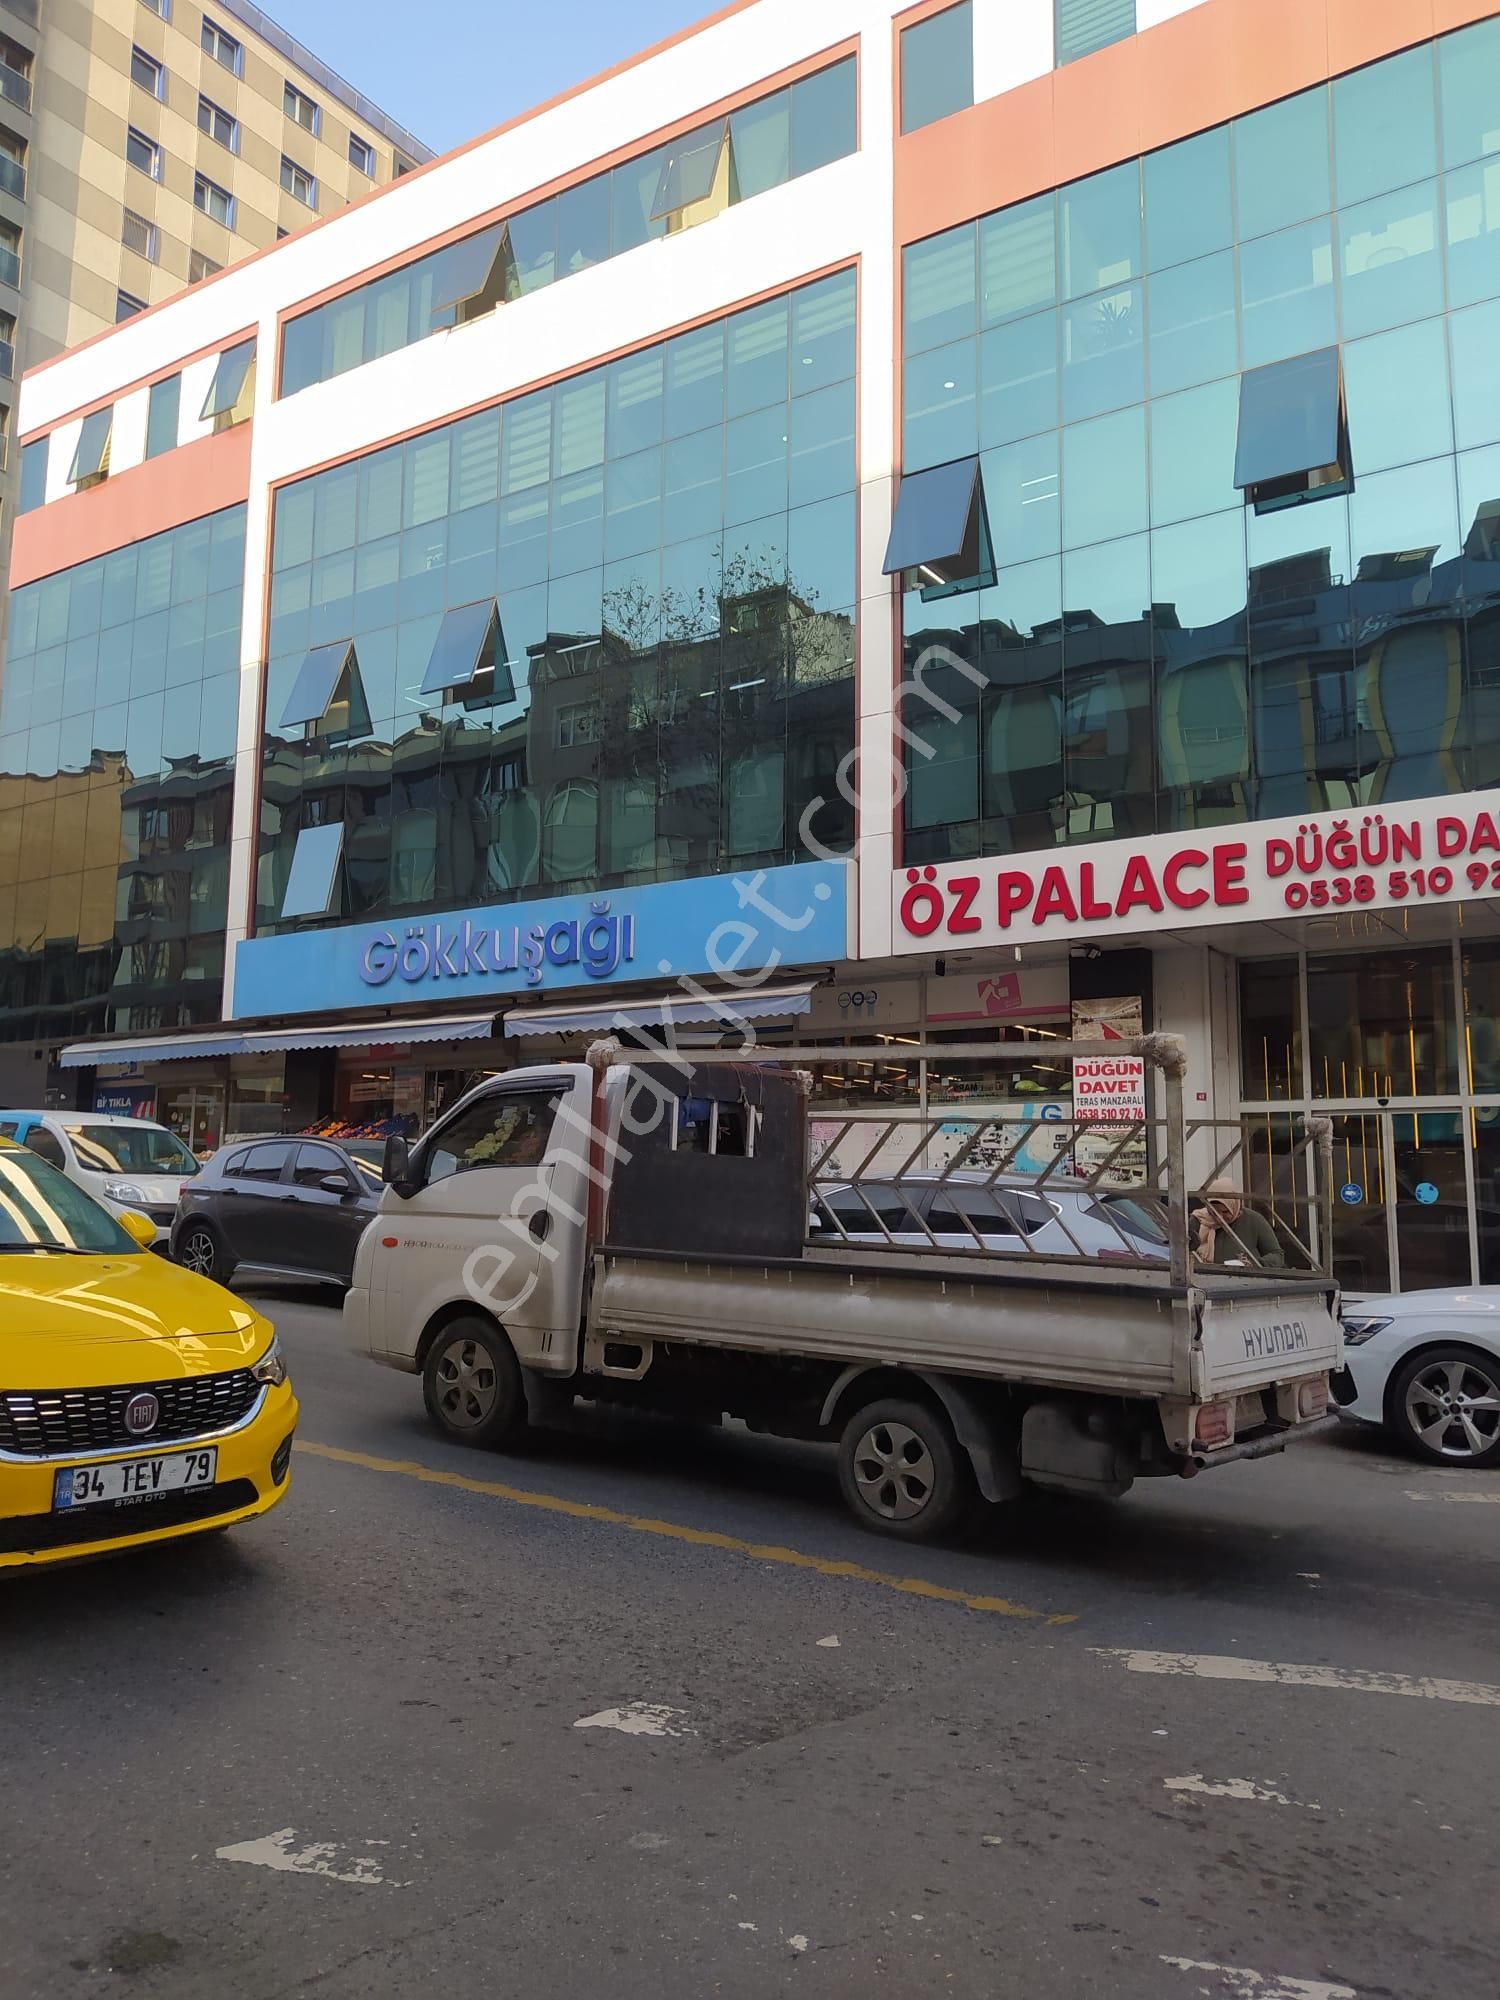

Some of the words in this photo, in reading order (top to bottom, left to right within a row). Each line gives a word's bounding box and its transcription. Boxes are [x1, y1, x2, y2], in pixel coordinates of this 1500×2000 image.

[1266, 814, 1421, 877] DÜĞÜN
[900, 865, 982, 936] ÖZ
[998, 842, 1249, 928] PALACE
[1285, 874, 1375, 909] 0538
[1389, 866, 1453, 899] 510
[360, 900, 636, 985] Gökkuşağı
[1075, 1060, 1142, 1077] DÜĞÜN
[1080, 1080, 1138, 1094] DAVET
[1077, 1097, 1098, 1106] TERAS
[1101, 1096, 1143, 1106] MANZARALI
[1077, 1109, 1098, 1119] 0538
[1102, 1109, 1116, 1119] 510
[1119, 1108, 1130, 1119] 92
[1133, 1108, 1143, 1119] 76
[1243, 1321, 1308, 1357] HYUNDAI
[133, 1405, 152, 1424] FIAT
[74, 1470, 104, 1500] 34
[122, 1460, 163, 1493] TEV
[184, 1452, 210, 1483] 79
[60, 1491, 71, 1499] TR
[114, 1495, 142, 1507] STAR
